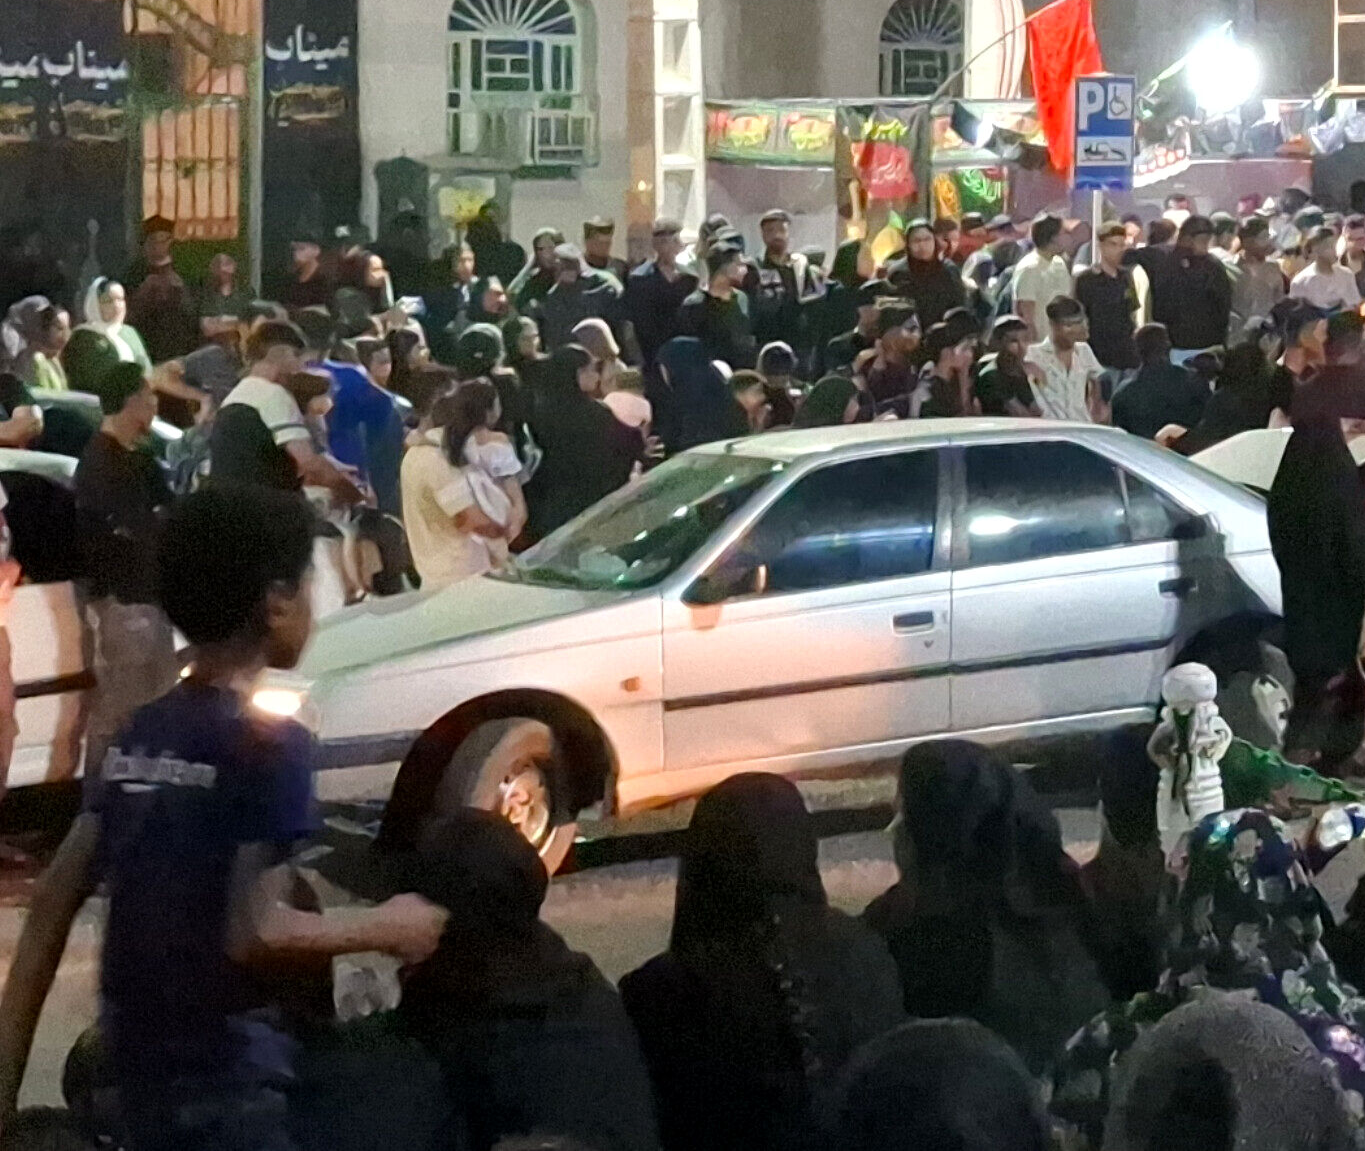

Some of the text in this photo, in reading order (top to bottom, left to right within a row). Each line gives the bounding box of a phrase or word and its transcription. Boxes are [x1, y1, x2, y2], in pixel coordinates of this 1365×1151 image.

[41, 39, 130, 91] میناب
[265, 23, 350, 72] میناب
[1078, 81, 1105, 132] P
